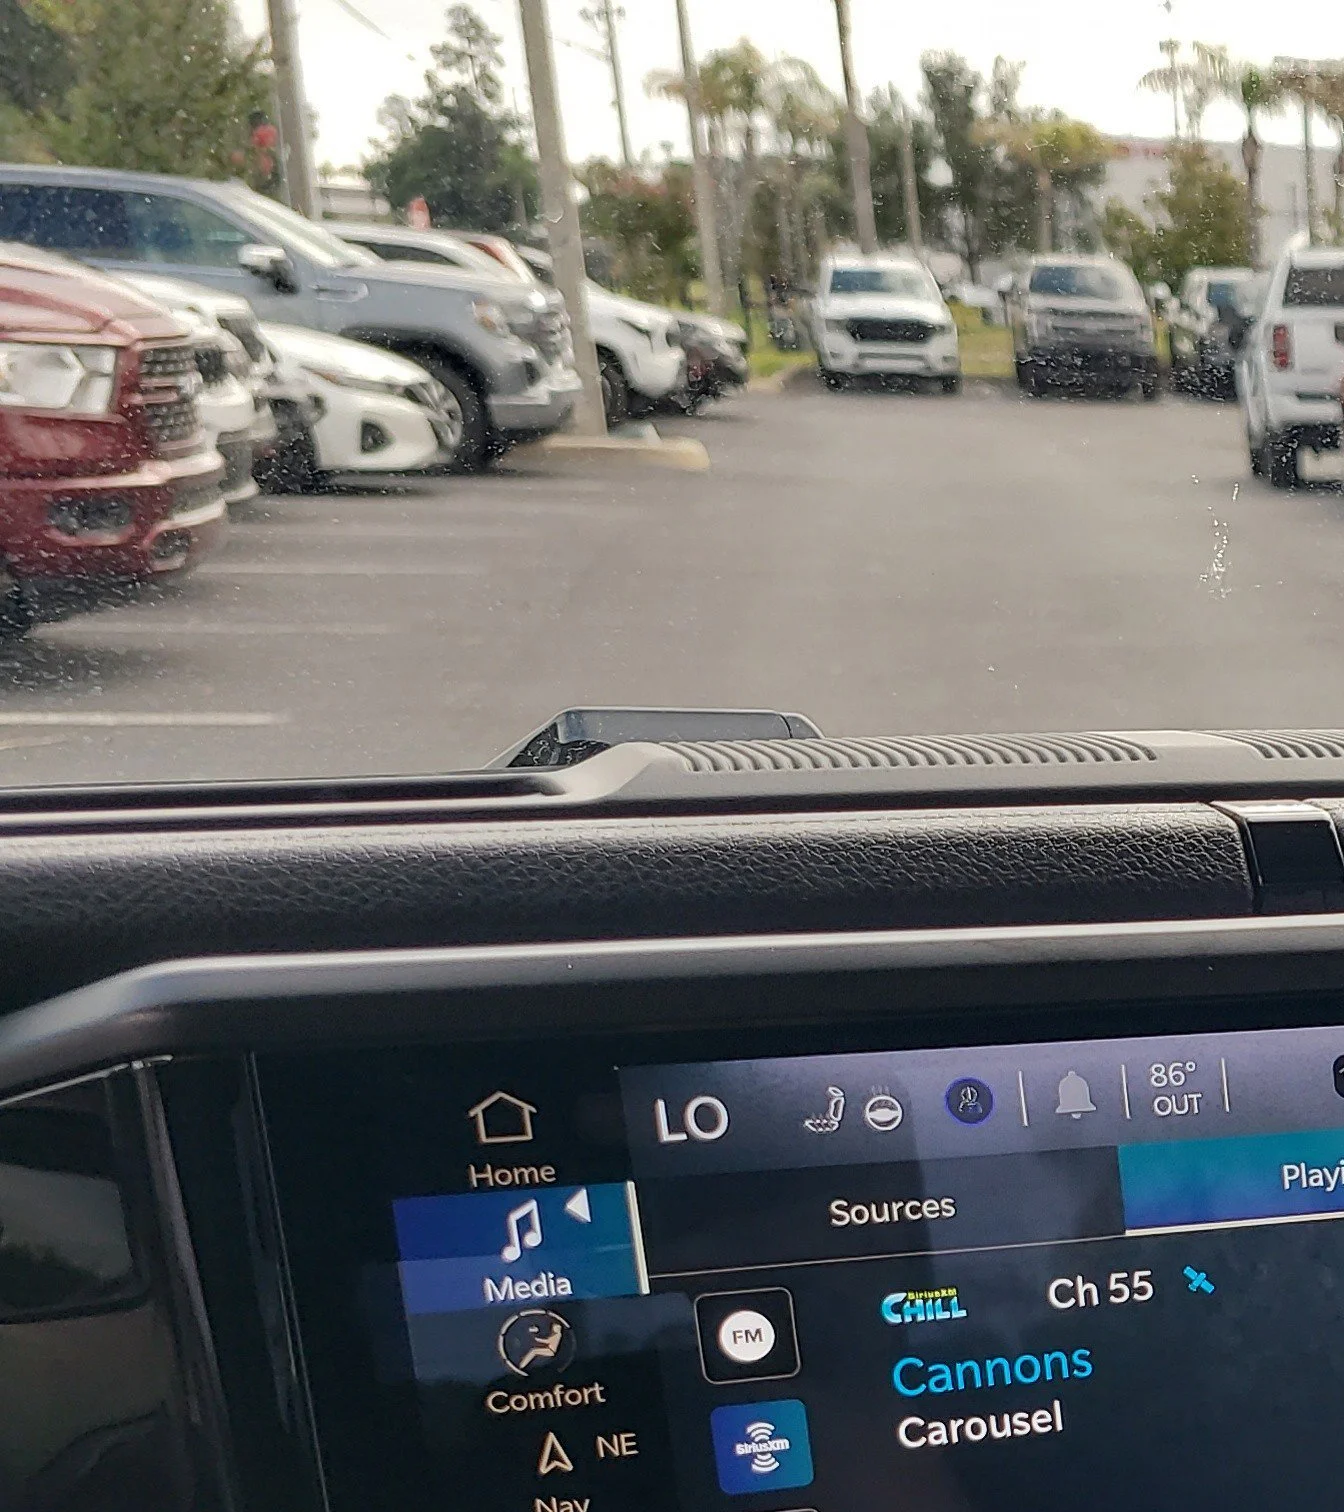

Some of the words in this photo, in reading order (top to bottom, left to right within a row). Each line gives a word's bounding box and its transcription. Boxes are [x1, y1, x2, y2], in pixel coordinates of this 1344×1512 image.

[1149, 1061, 1197, 1088] 86°
[653, 1096, 729, 1143] LO
[1153, 1092, 1202, 1117] OUT
[467, 1162, 557, 1187] Home
[830, 1197, 956, 1227] Sources
[483, 1272, 572, 1299] Media
[1048, 1275, 1098, 1309] Ch
[1108, 1271, 1154, 1304] 55
[882, 1292, 968, 1324] CHILL
[732, 1328, 764, 1344] FM
[892, 1344, 1093, 1397] Cannons
[486, 1382, 606, 1414] Comfort
[898, 1400, 1063, 1449] Carousel
[596, 1433, 639, 1458] NE
